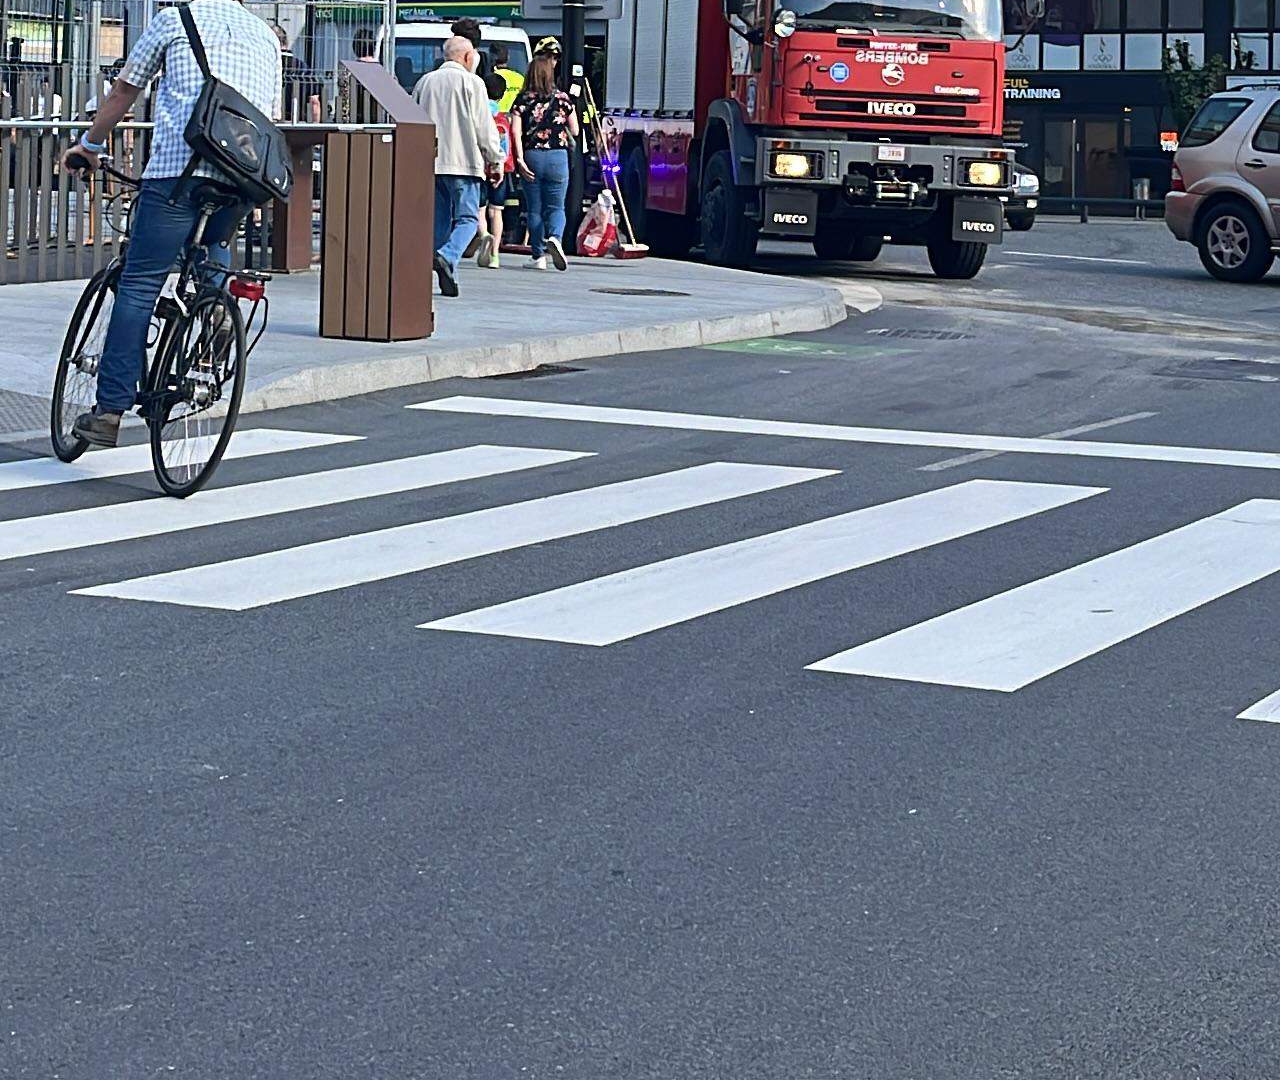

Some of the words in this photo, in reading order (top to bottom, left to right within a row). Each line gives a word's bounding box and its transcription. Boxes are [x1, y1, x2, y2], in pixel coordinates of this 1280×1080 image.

[1003, 88, 1061, 99] TRAINING
[867, 101, 916, 116] IVECO
[773, 213, 808, 225] IVECO
[962, 221, 995, 233] IVECO
